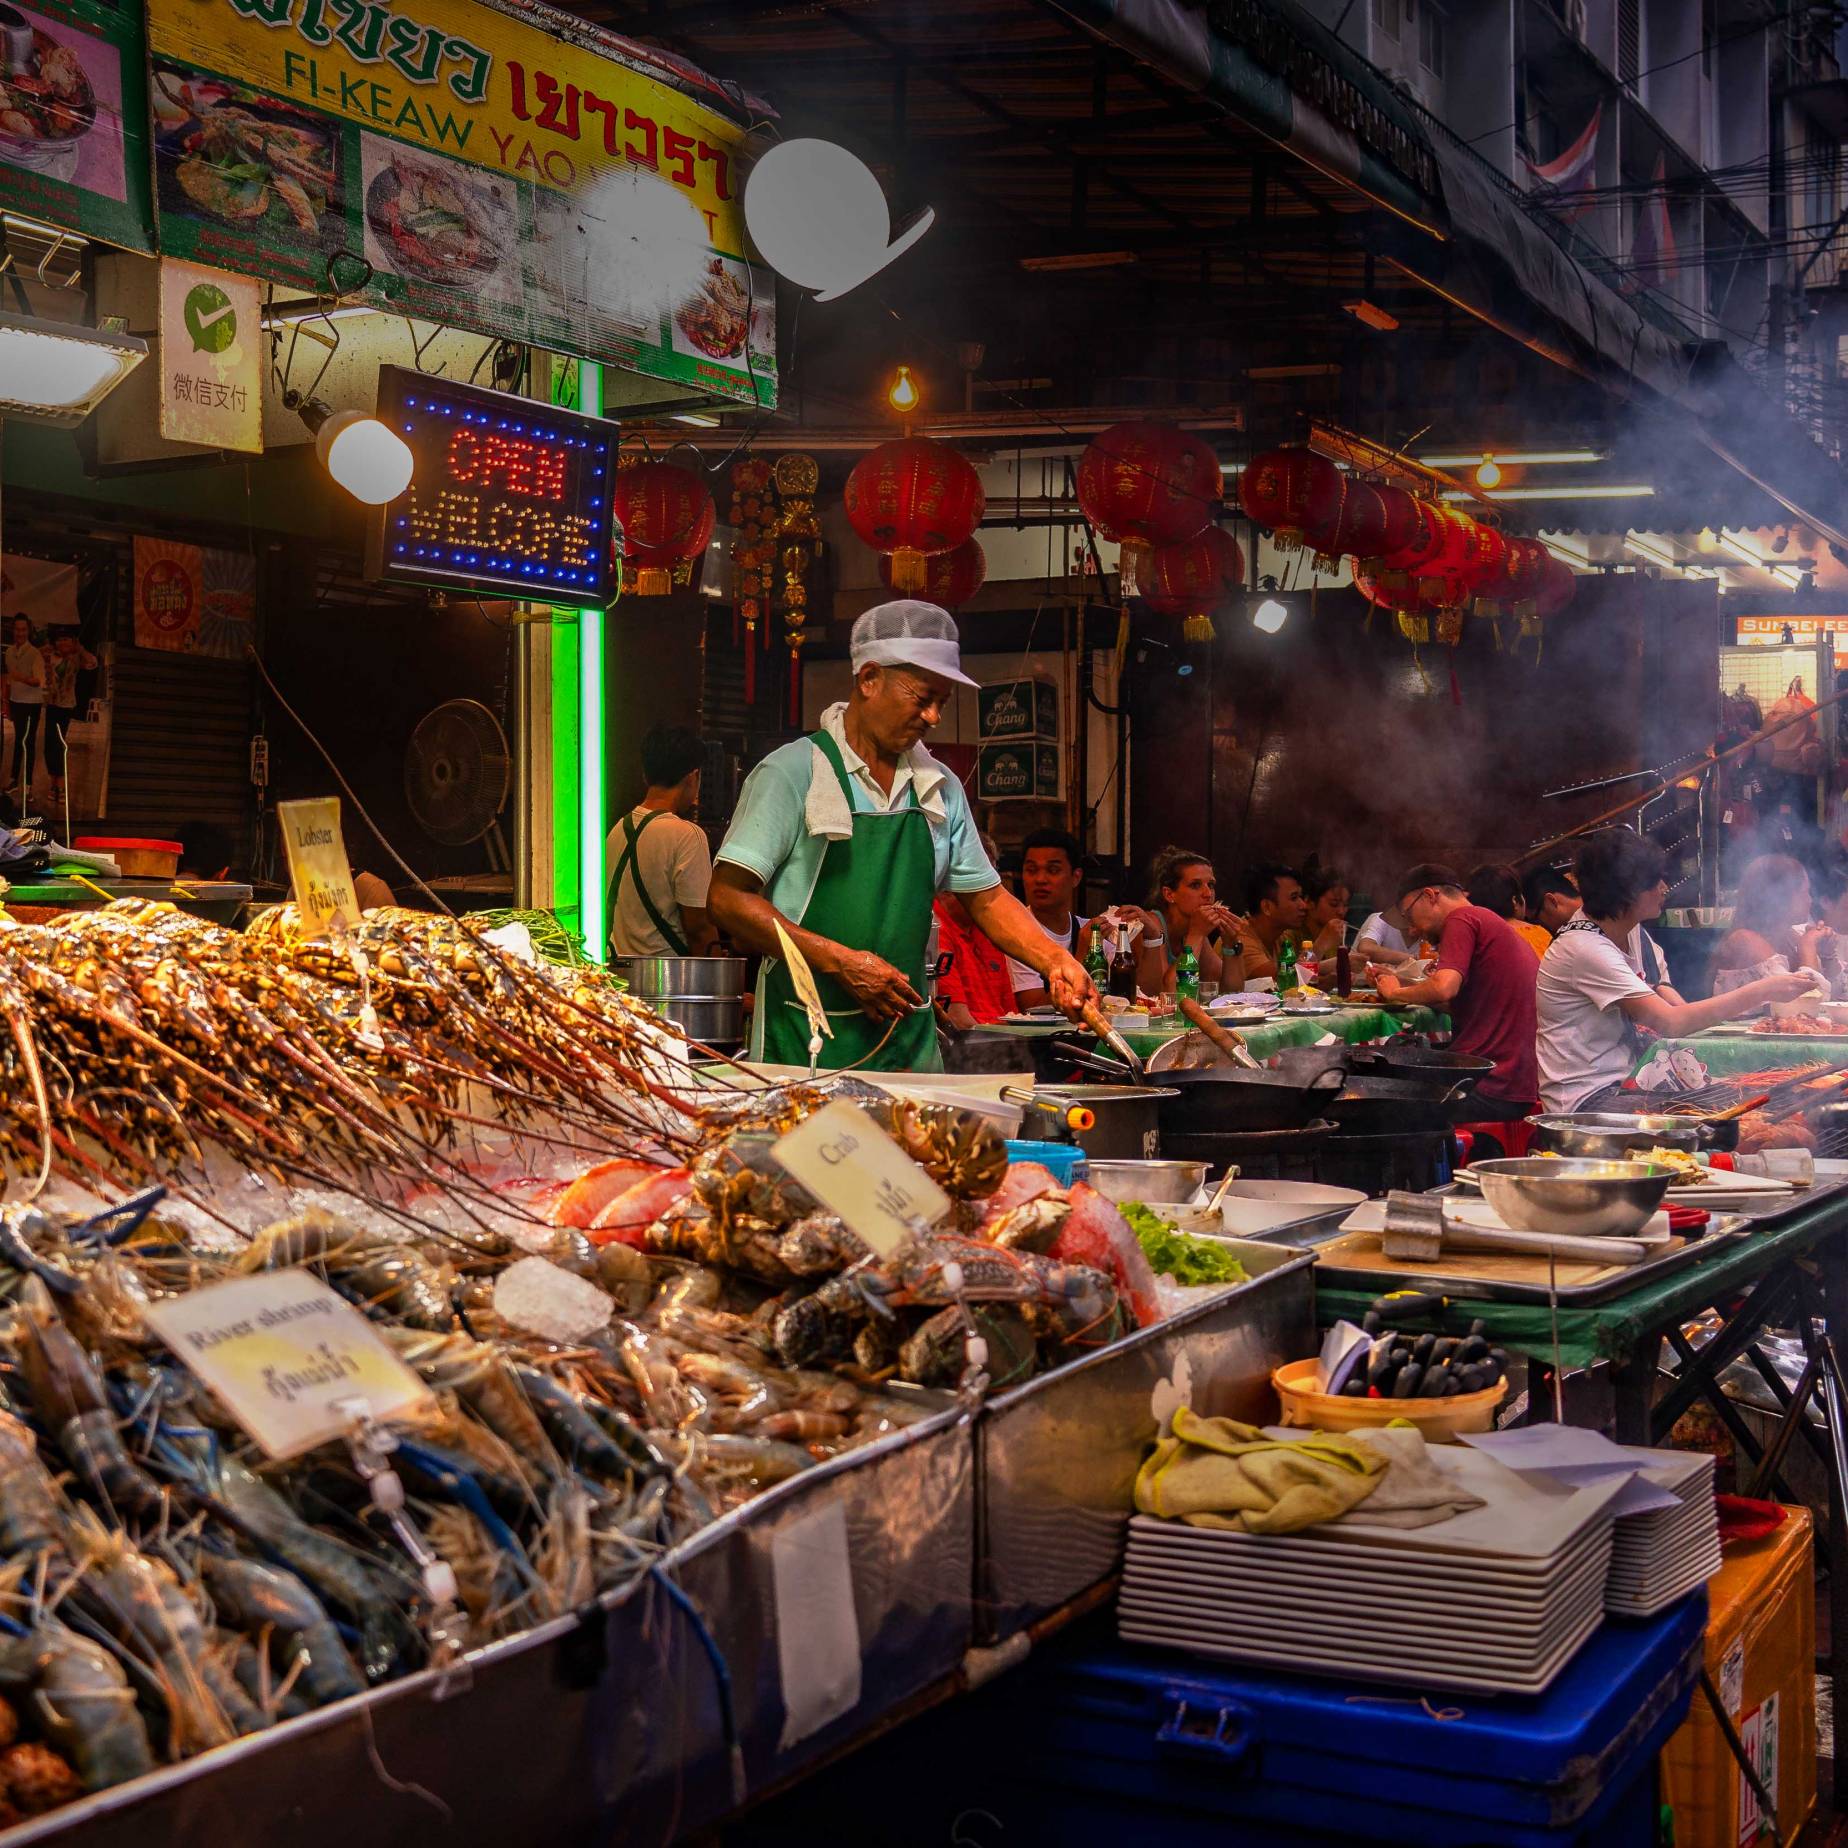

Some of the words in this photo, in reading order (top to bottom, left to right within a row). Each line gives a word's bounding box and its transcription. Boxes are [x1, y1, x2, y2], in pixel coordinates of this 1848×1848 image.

[284, 49, 474, 149] FI-KEAW
[174, 373, 248, 412] 微信支付
[449, 430, 567, 500] OPEN
[409, 484, 590, 566] WELCOME
[986, 711, 1026, 728] Chang
[987, 772, 1026, 788] Chang
[296, 825, 333, 847] Lobster
[819, 1129, 860, 1165] Crab
[185, 1319, 256, 1352] River
[256, 1297, 333, 1328] shrimp
